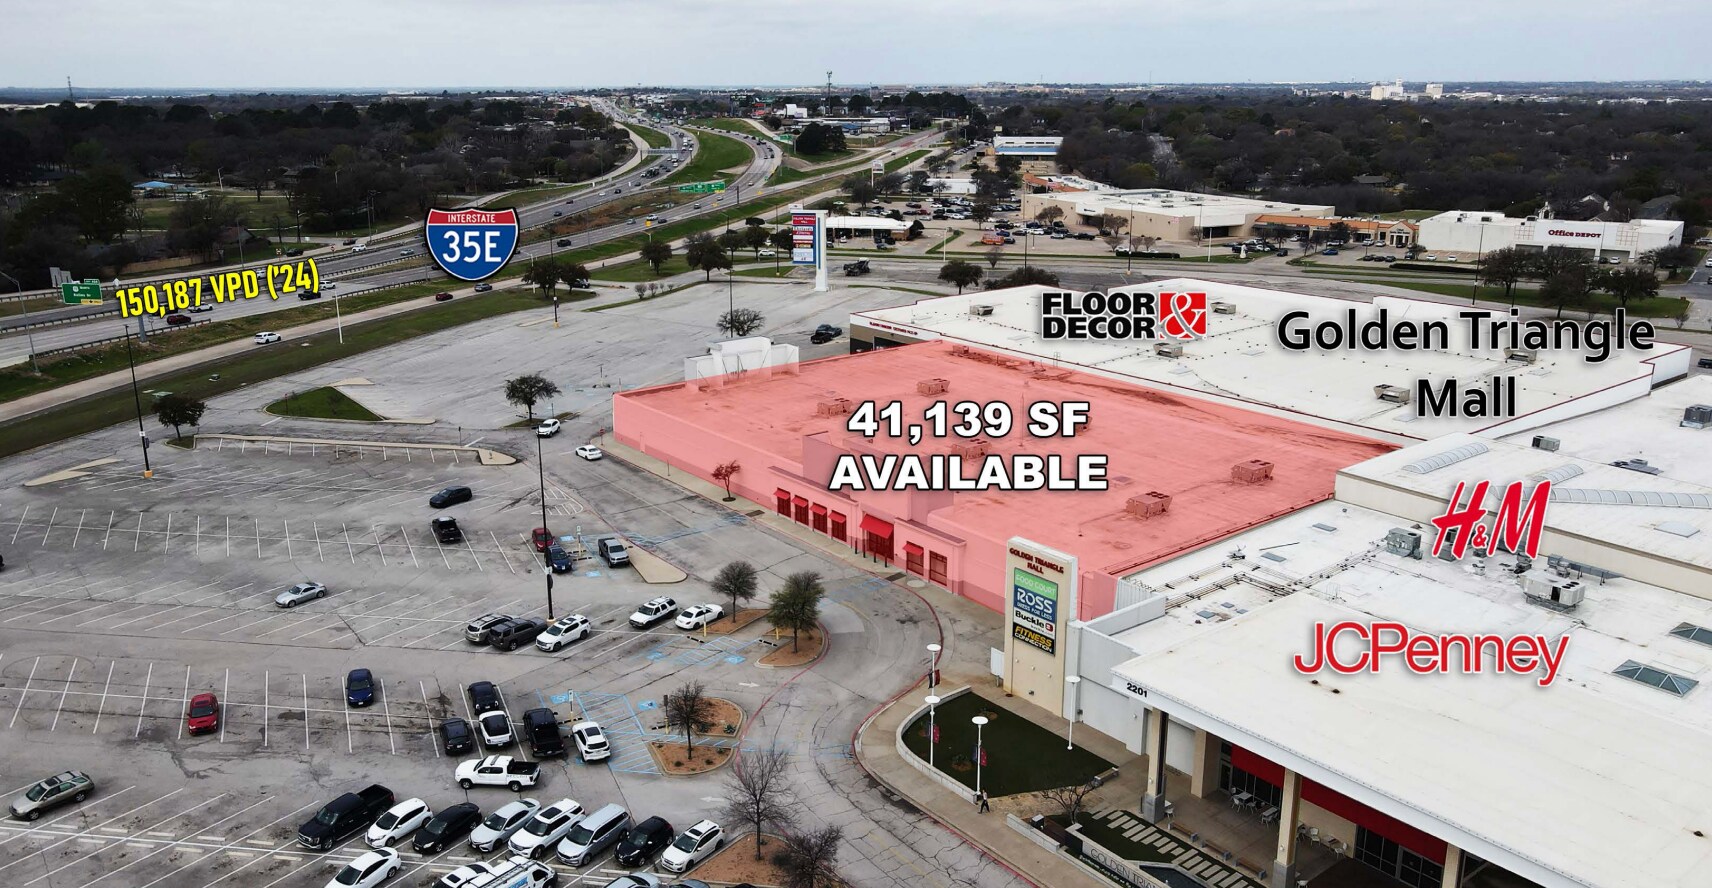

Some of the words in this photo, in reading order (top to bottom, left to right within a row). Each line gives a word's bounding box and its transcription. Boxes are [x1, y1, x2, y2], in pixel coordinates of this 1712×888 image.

[1548, 229, 1574, 237] Office
[1009, 547, 1034, 562] GOLDEN
[1034, 556, 1064, 574] TRIANGLE
[1017, 588, 1053, 614] ROSS
[1015, 610, 1045, 629] Buckle
[1014, 632, 1052, 653] CONNECTION
[1015, 625, 1052, 648] FITNESS
[1127, 682, 1147, 698] 2201
[1090, 848, 1131, 880] GOLDEN
[1132, 872, 1156, 888] TRIA
